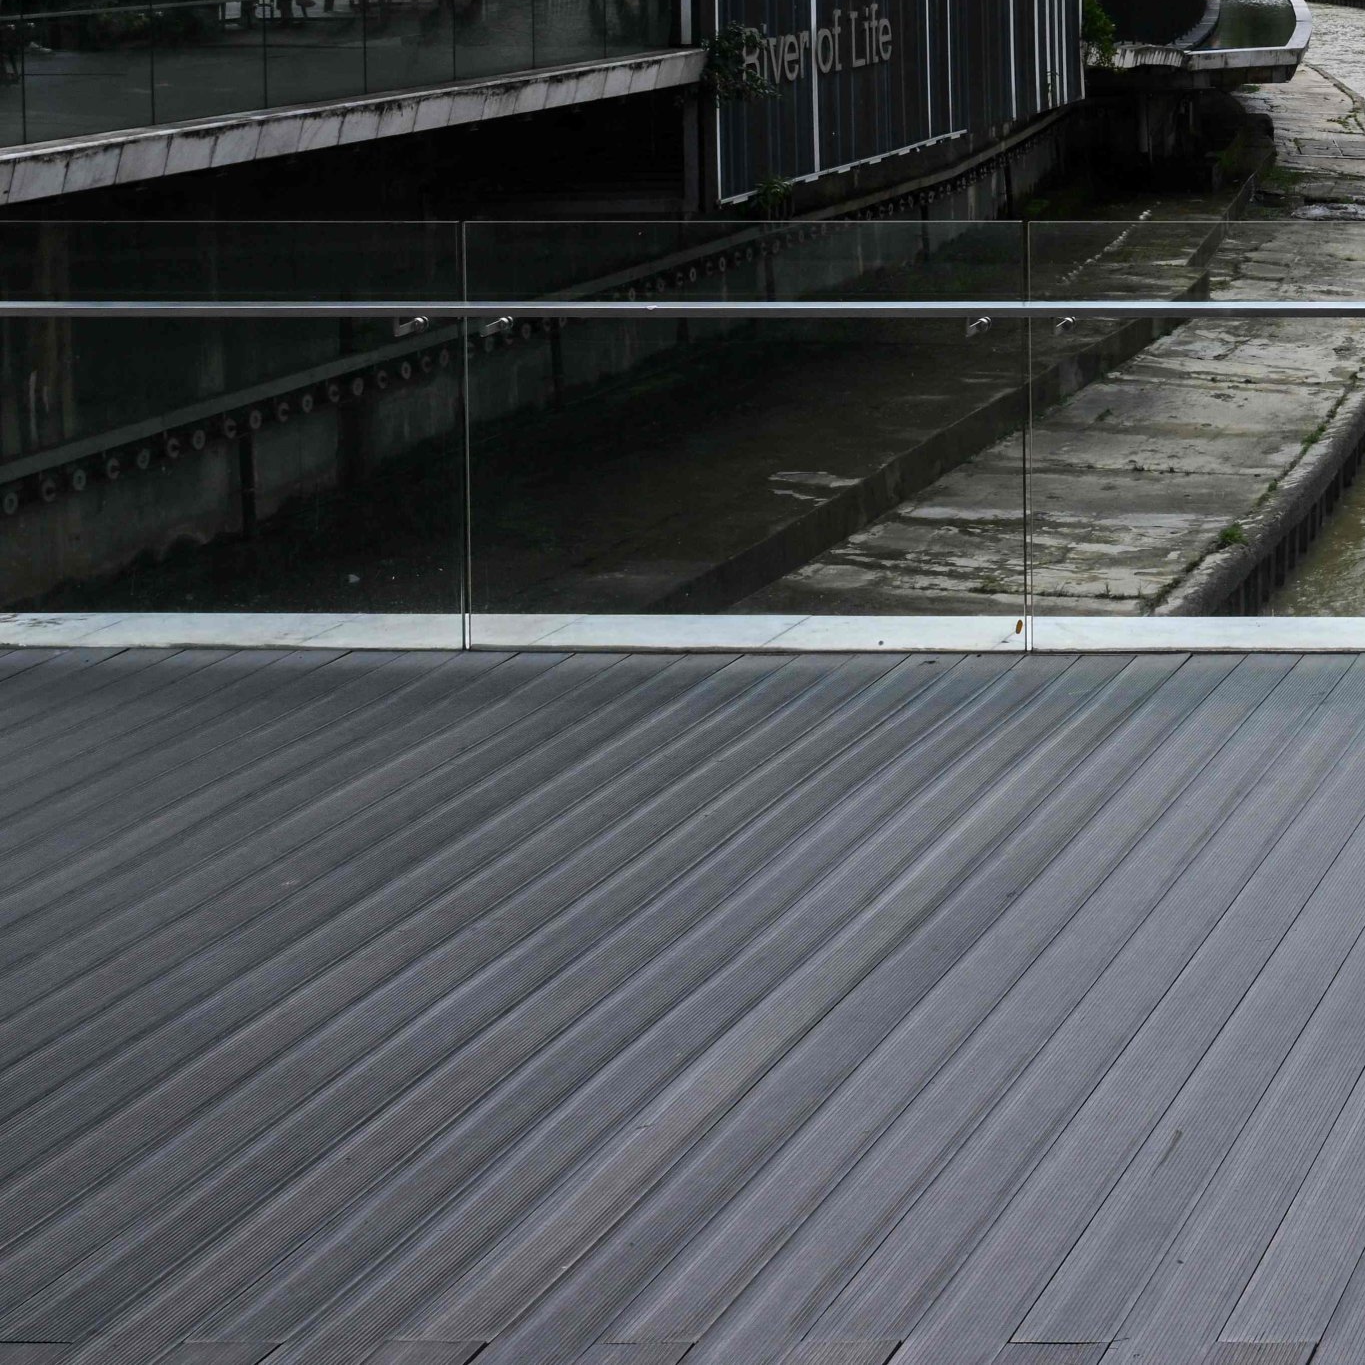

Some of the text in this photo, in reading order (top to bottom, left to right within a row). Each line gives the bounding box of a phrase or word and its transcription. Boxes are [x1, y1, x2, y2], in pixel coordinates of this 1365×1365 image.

[742, 2, 893, 85] River of Life
